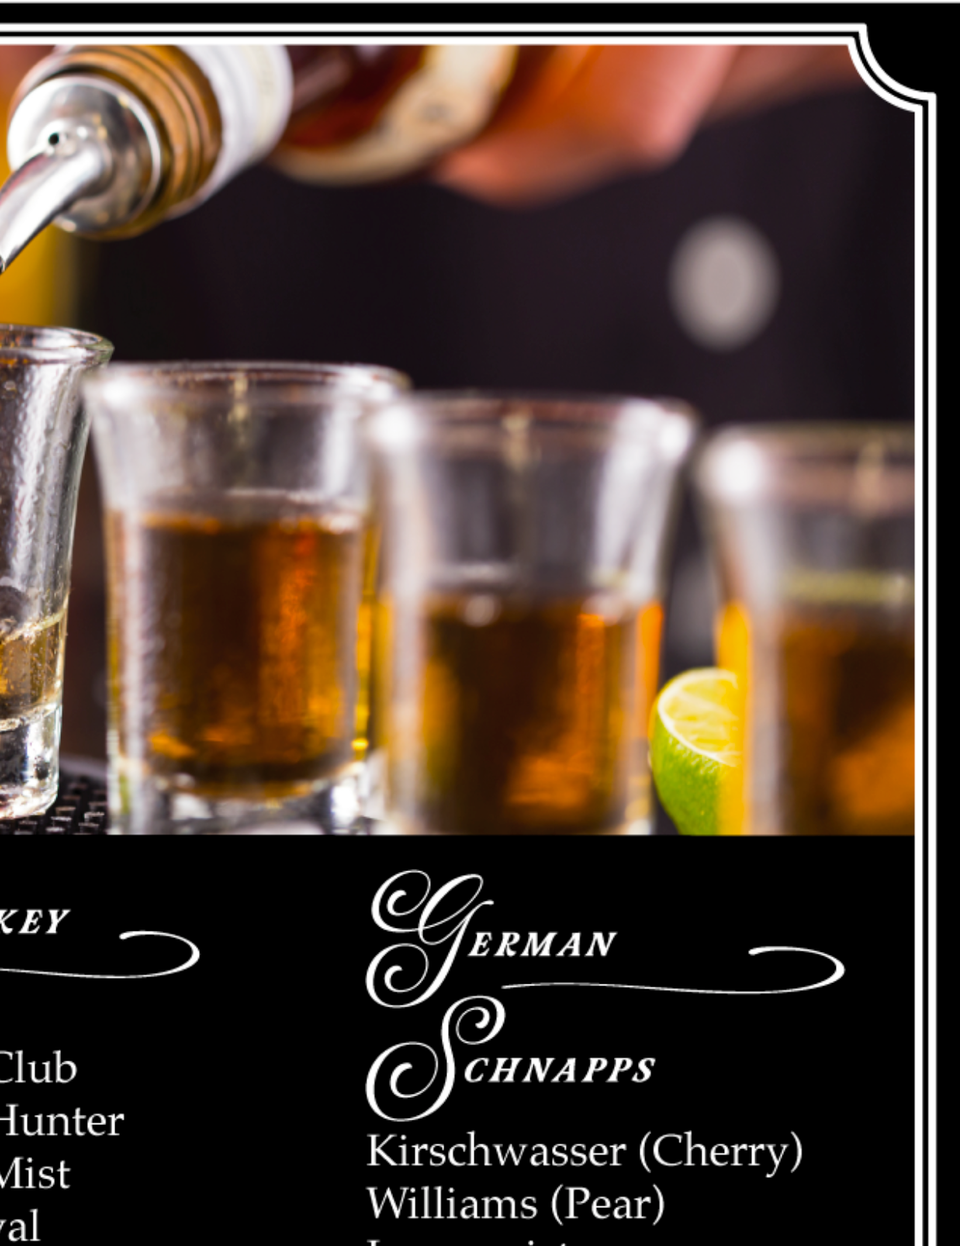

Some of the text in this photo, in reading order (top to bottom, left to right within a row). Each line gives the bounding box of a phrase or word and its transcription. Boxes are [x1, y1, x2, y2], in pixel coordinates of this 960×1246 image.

[365, 869, 618, 1008] GERMAN
[365, 995, 657, 1122] SCHNAPPS
[366, 1129, 803, 1179] Kirschwasser (Cherry)
[365, 1183, 665, 1226] Williams (Pear)
